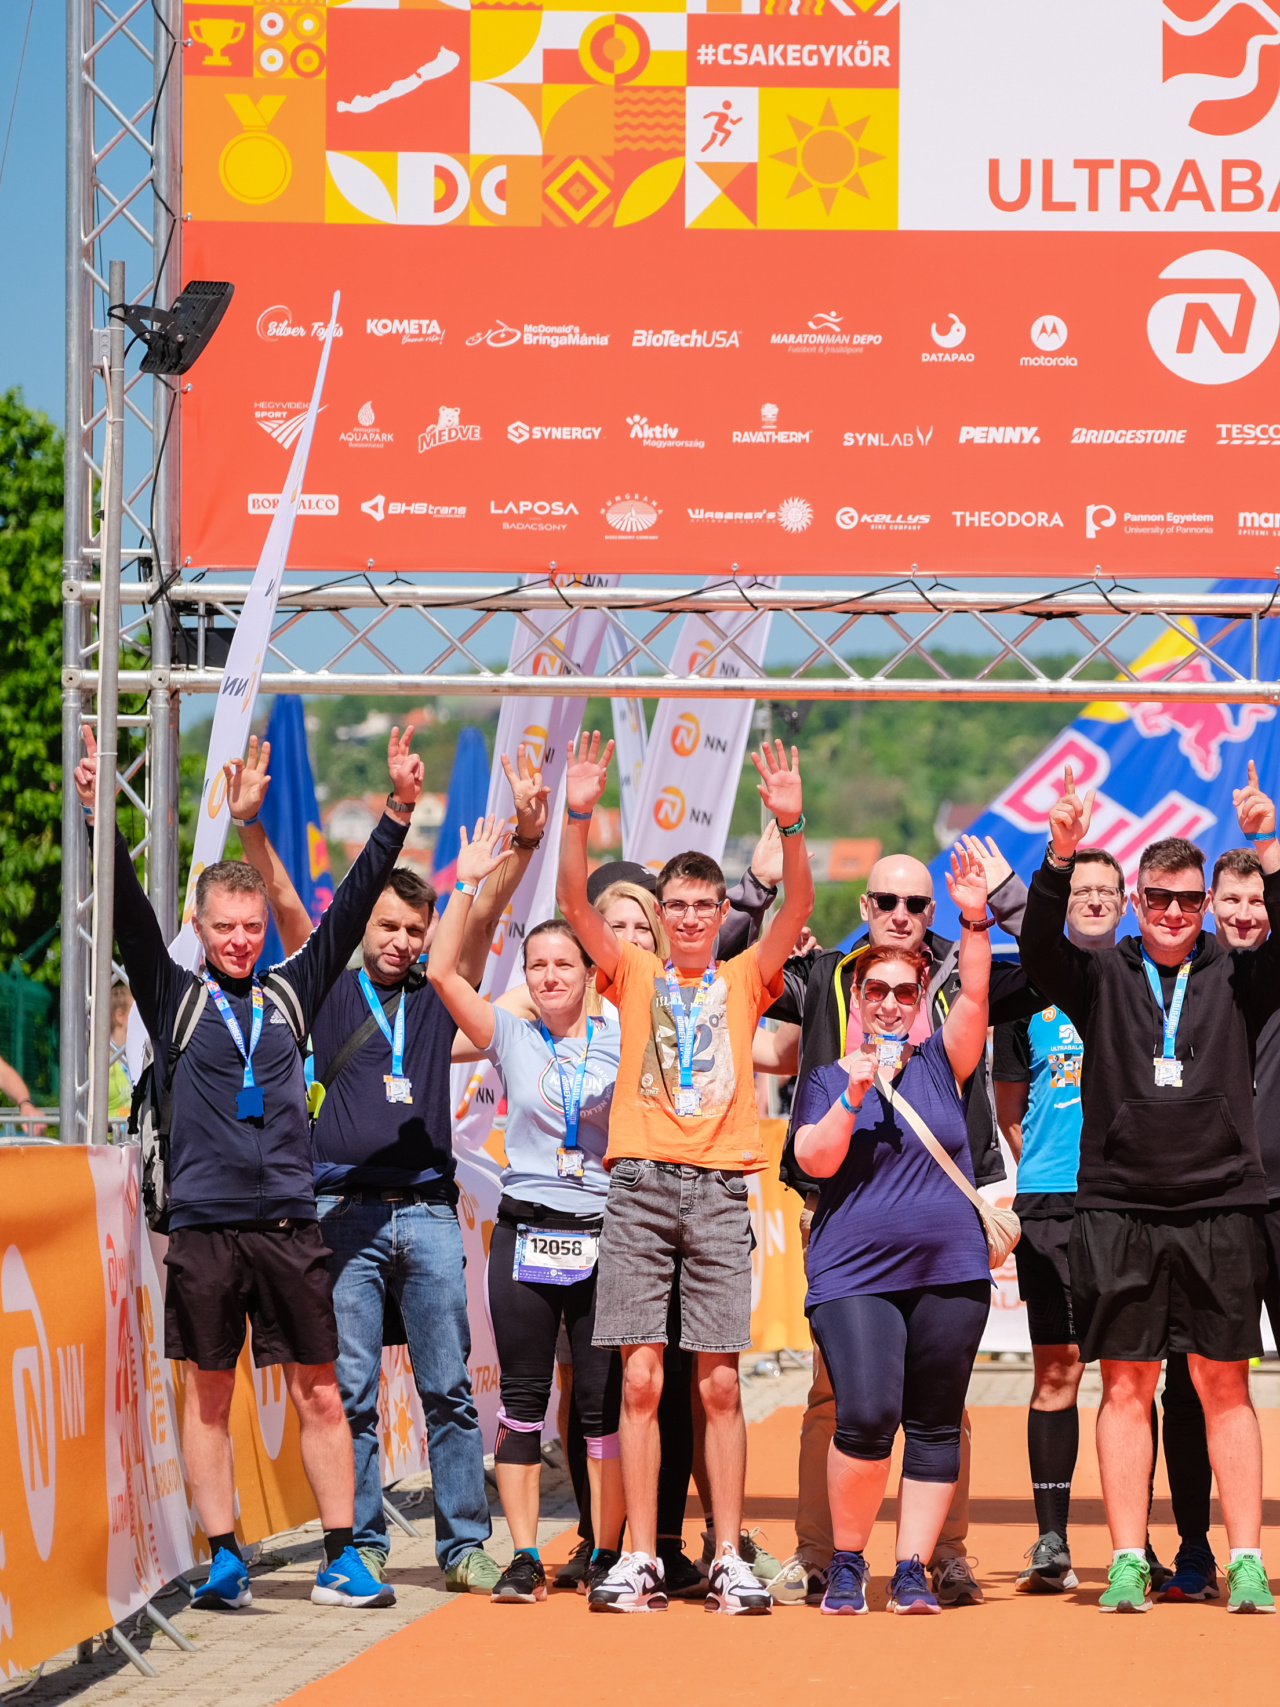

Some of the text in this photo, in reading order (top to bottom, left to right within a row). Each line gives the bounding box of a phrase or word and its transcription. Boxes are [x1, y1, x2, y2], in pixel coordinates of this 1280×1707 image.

[696, 41, 892, 68] #CSAKEGYKÖR
[266, 319, 344, 341] Silver Tojs
[366, 318, 441, 337] KOMETA
[523, 324, 580, 335] McDonald's
[523, 332, 608, 347] BringaMánia
[632, 329, 740, 348] BioTechUSA
[770, 333, 882, 345] MARATONMAN DEPO
[921, 353, 975, 362] DATAPAO
[1020, 355, 1078, 367] motorola
[339, 432, 394, 442] AQUAPARK
[418, 425, 481, 453] MEDVE
[531, 426, 602, 440] SYNERGY
[732, 431, 810, 443] RAVATHERM
[843, 431, 914, 447] SYNLAB
[958, 426, 1041, 444] PENNY.
[1070, 427, 1187, 444] BRIDGESTONE
[643, 438, 705, 449] Magyarország
[388, 502, 467, 515] BHStrans
[490, 501, 579, 515] LAPOSA
[860, 512, 931, 525] KELLYS
[952, 511, 1065, 528] THEODORA
[1123, 512, 1214, 525] Pannon Egyetem
[502, 522, 567, 531] BADACSONY
[1124, 525, 1214, 536] University of Pannonia
[719, 661, 740, 678] NN
[704, 735, 728, 753] NN
[690, 808, 713, 826] NN
[476, 1087, 495, 1105] NN
[530, 1237, 583, 1256] 12058
[56, 1343, 86, 1441] NN
